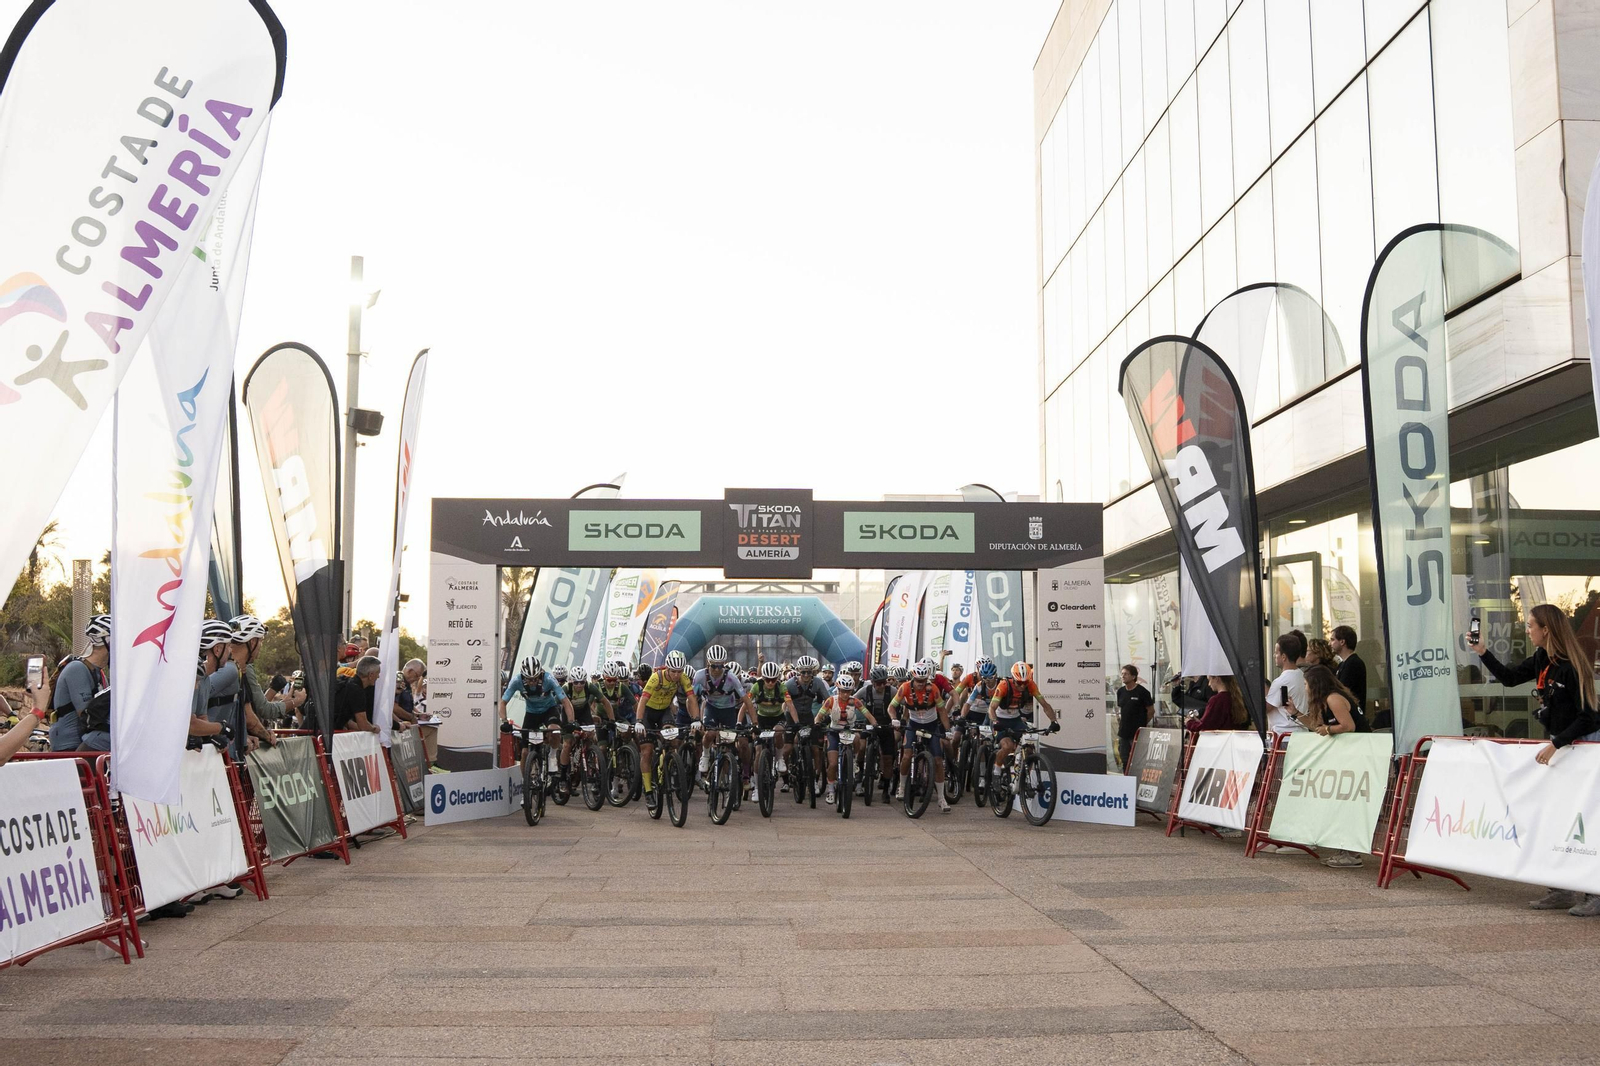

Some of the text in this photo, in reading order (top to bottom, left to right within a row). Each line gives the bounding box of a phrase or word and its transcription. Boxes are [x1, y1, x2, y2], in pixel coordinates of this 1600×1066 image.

[56, 66, 194, 275] COSTA DE
[84, 99, 253, 354] ALMERÍA
[482, 509, 553, 528] Andalucía
[728, 504, 801, 528] TITAN
[738, 534, 801, 545] DESERT
[989, 542, 1036, 550] DIPUTACIÓN
[1050, 542, 1083, 551] ALMERÍA
[746, 548, 791, 558] ALMERÍA
[718, 606, 802, 616] UNIVERSAE
[340, 753, 382, 801] MRW
[1188, 767, 1250, 810] MRW
[449, 785, 503, 806] Cleardent
[1060, 790, 1128, 809] Cleardent
[0, 808, 81, 856] COSTA DE
[1424, 796, 1522, 850] Andalucía
[0, 846, 95, 932] ALMERÍA
